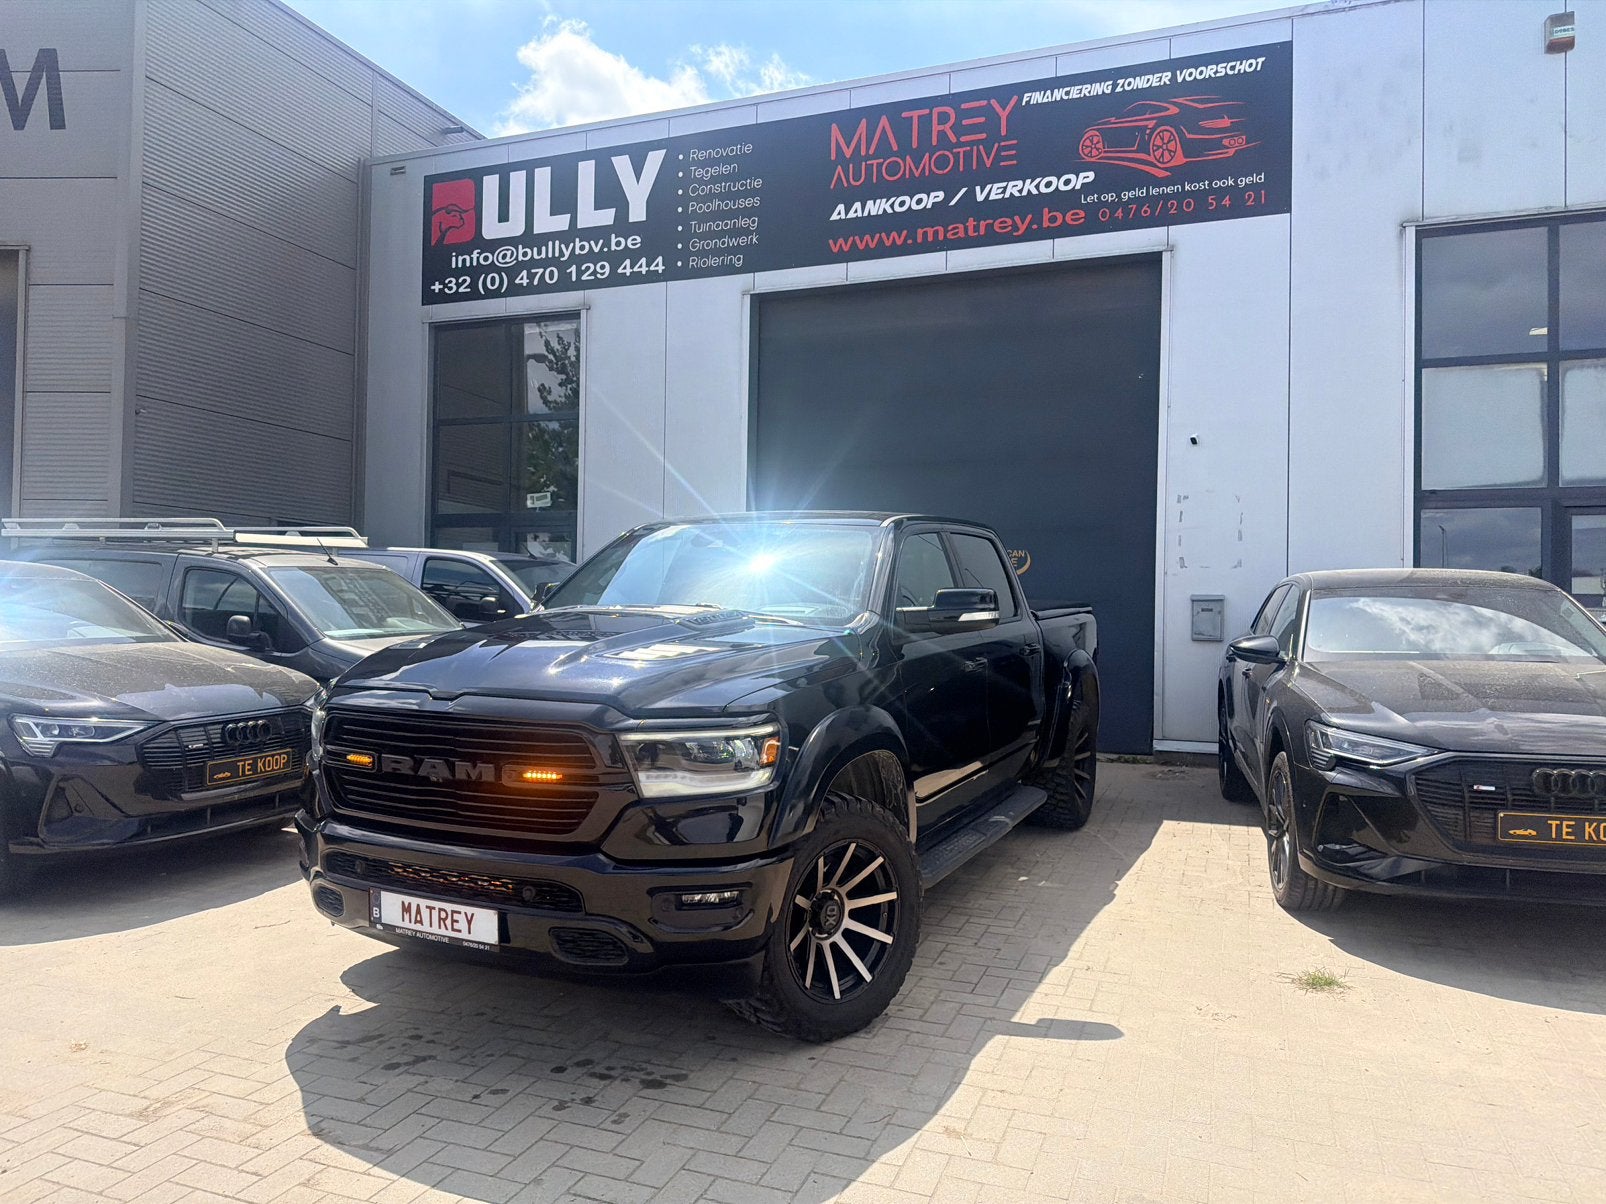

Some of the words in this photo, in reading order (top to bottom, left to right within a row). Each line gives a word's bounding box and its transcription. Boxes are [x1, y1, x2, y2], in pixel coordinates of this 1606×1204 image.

[1022, 80, 1113, 106] FINANCIERING
[1115, 71, 1172, 94] ZONDER
[1176, 57, 1266, 84] VOORSCHOT
[830, 95, 1019, 161] MATREY
[689, 142, 753, 161] Renovatie
[689, 162, 738, 181] Tegelen
[829, 139, 1018, 190] AUTOMOTIVE
[688, 176, 763, 197] Constructie
[829, 190, 945, 221] AANKOOP
[949, 187, 968, 206] /
[974, 170, 1095, 203] VERKOOP
[1081, 193, 1098, 204] Let
[1101, 190, 1118, 203] op,
[1121, 187, 1147, 202] geld
[1149, 183, 1182, 196] lenen
[1185, 180, 1209, 192] kost
[1212, 176, 1235, 188] ook
[1237, 172, 1265, 187] geld
[688, 196, 761, 215] Poolhouses
[1098, 198, 1194, 222] 0476/20
[1208, 195, 1231, 210] 54
[1245, 190, 1266, 206] 21
[689, 215, 758, 234] Tuinaanleg
[828, 207, 1086, 254] www.matrey.be
[451, 233, 642, 269] info@bullybv.be
[689, 232, 760, 252] Grondwerk
[688, 253, 744, 269] Riolering
[430, 275, 471, 294] +32
[478, 271, 508, 295] (0)
[514, 266, 559, 287] 470
[566, 261, 610, 282] 129
[617, 255, 666, 277] 444
[237, 760, 253, 776] TE
[257, 754, 288, 773] KOOP
[381, 753, 496, 782] RAM
[1547, 820, 1576, 840] TE
[372, 906, 380, 918] B
[401, 900, 475, 935] MATREY
[395, 927, 416, 937] MATREY
[416, 931, 450, 944] AUTOMOTIVE
